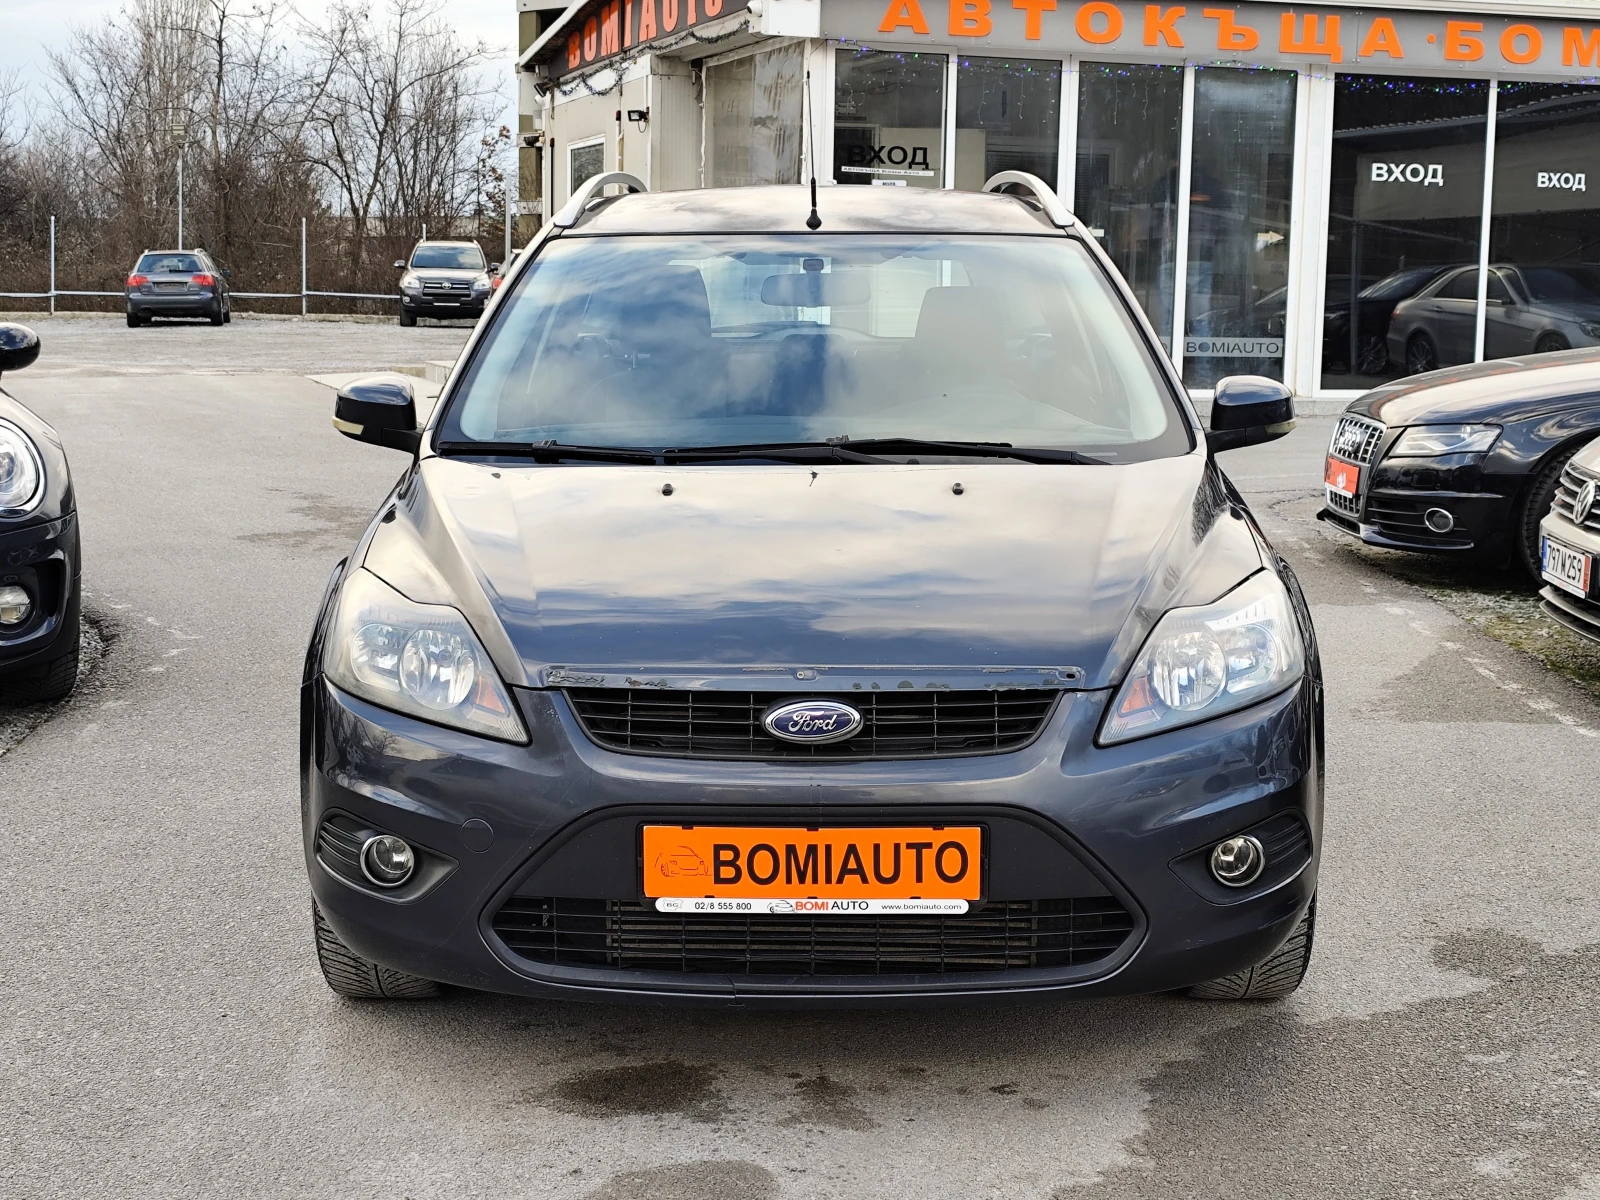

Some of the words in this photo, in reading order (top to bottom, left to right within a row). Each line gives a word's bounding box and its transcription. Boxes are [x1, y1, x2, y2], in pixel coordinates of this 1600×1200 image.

[878, 0, 1404, 63] АВТОКЪЩА
[848, 145, 929, 169] ВХОД
[1371, 163, 1444, 186] ВХОД
[1537, 172, 1586, 192] ВХОД
[1186, 342, 1279, 354] BOMIAUTO
[788, 710, 838, 732] Ford
[713, 840, 969, 885] BOMIAUTO
[694, 902, 715, 910] 02/8
[717, 902, 734, 910] 555
[735, 902, 752, 910] 800
[795, 901, 829, 911] BOMI
[831, 901, 869, 911] AUTO
